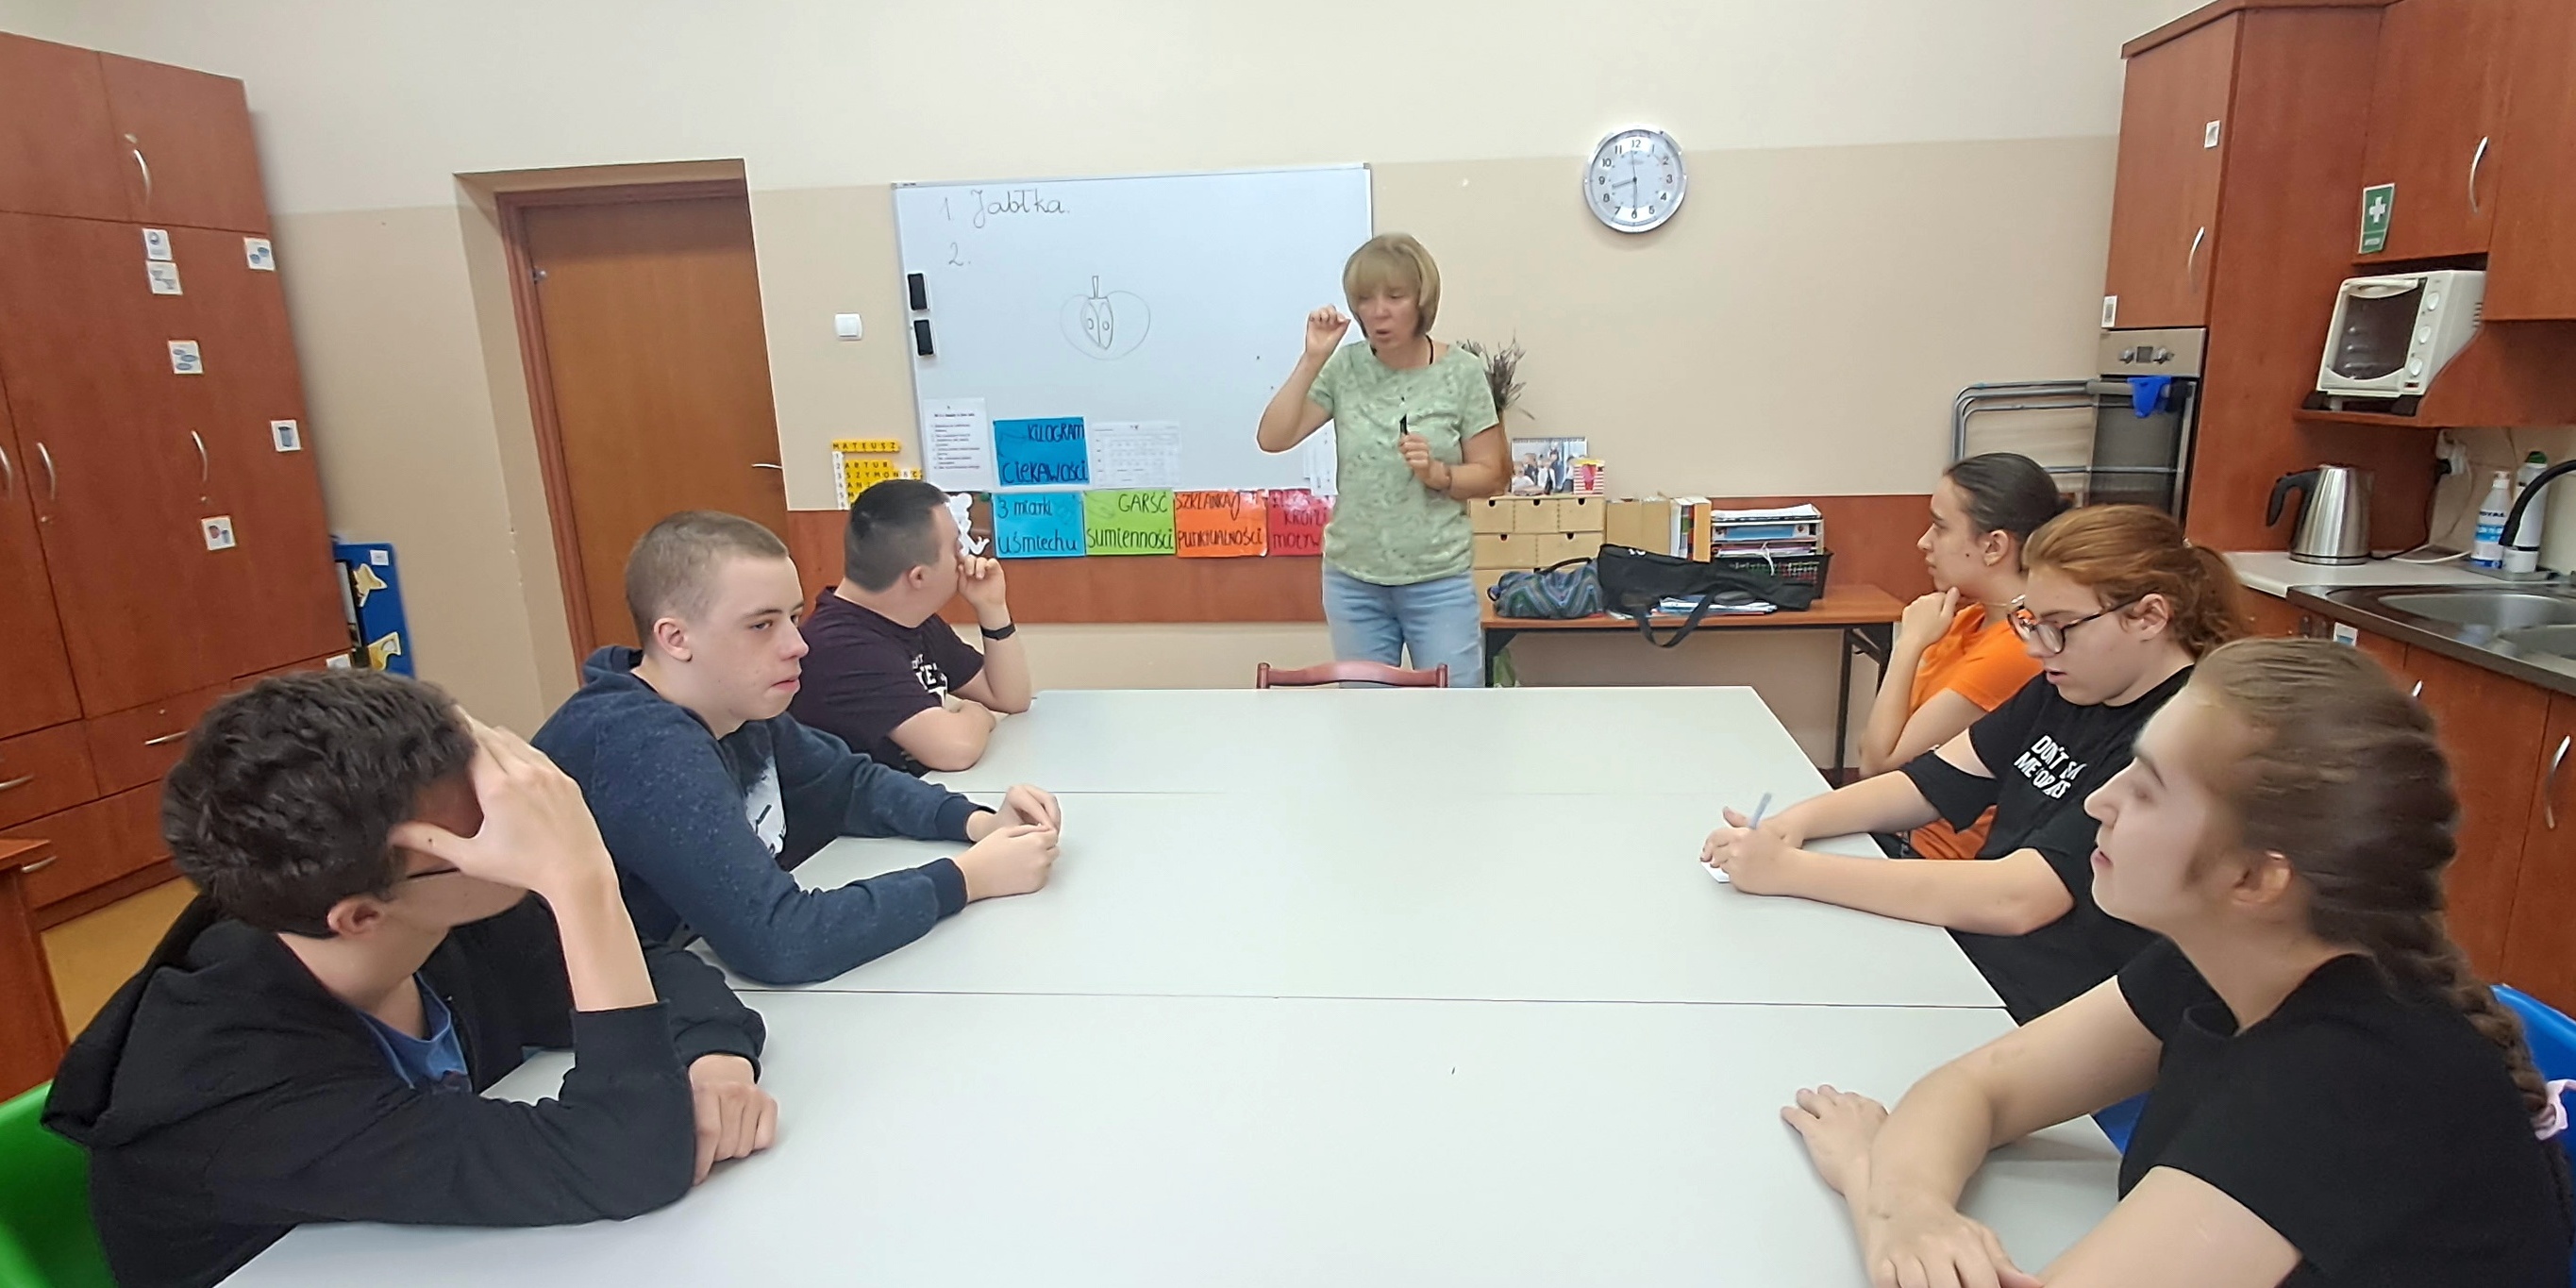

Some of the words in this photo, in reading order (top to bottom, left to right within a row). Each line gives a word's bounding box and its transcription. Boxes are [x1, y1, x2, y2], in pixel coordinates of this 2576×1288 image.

[1631, 139, 1642, 148] 12
[1614, 145, 1623, 155] 11
[1602, 158, 1612, 168] 10
[1663, 157, 1669, 165] 2
[1598, 176, 1606, 185] 9
[1666, 174, 1673, 184] 3
[1603, 193, 1611, 203] 8
[1661, 192, 1667, 201] 4
[1614, 206, 1621, 215] 7
[1631, 209, 1638, 219] 6
[1648, 205, 1655, 215] 5
[832, 442, 896, 450] MATEUSZ
[997, 495, 1009, 519] 3
[1118, 491, 1169, 514] GARŚĆ
[2013, 751, 2042, 778] ME
